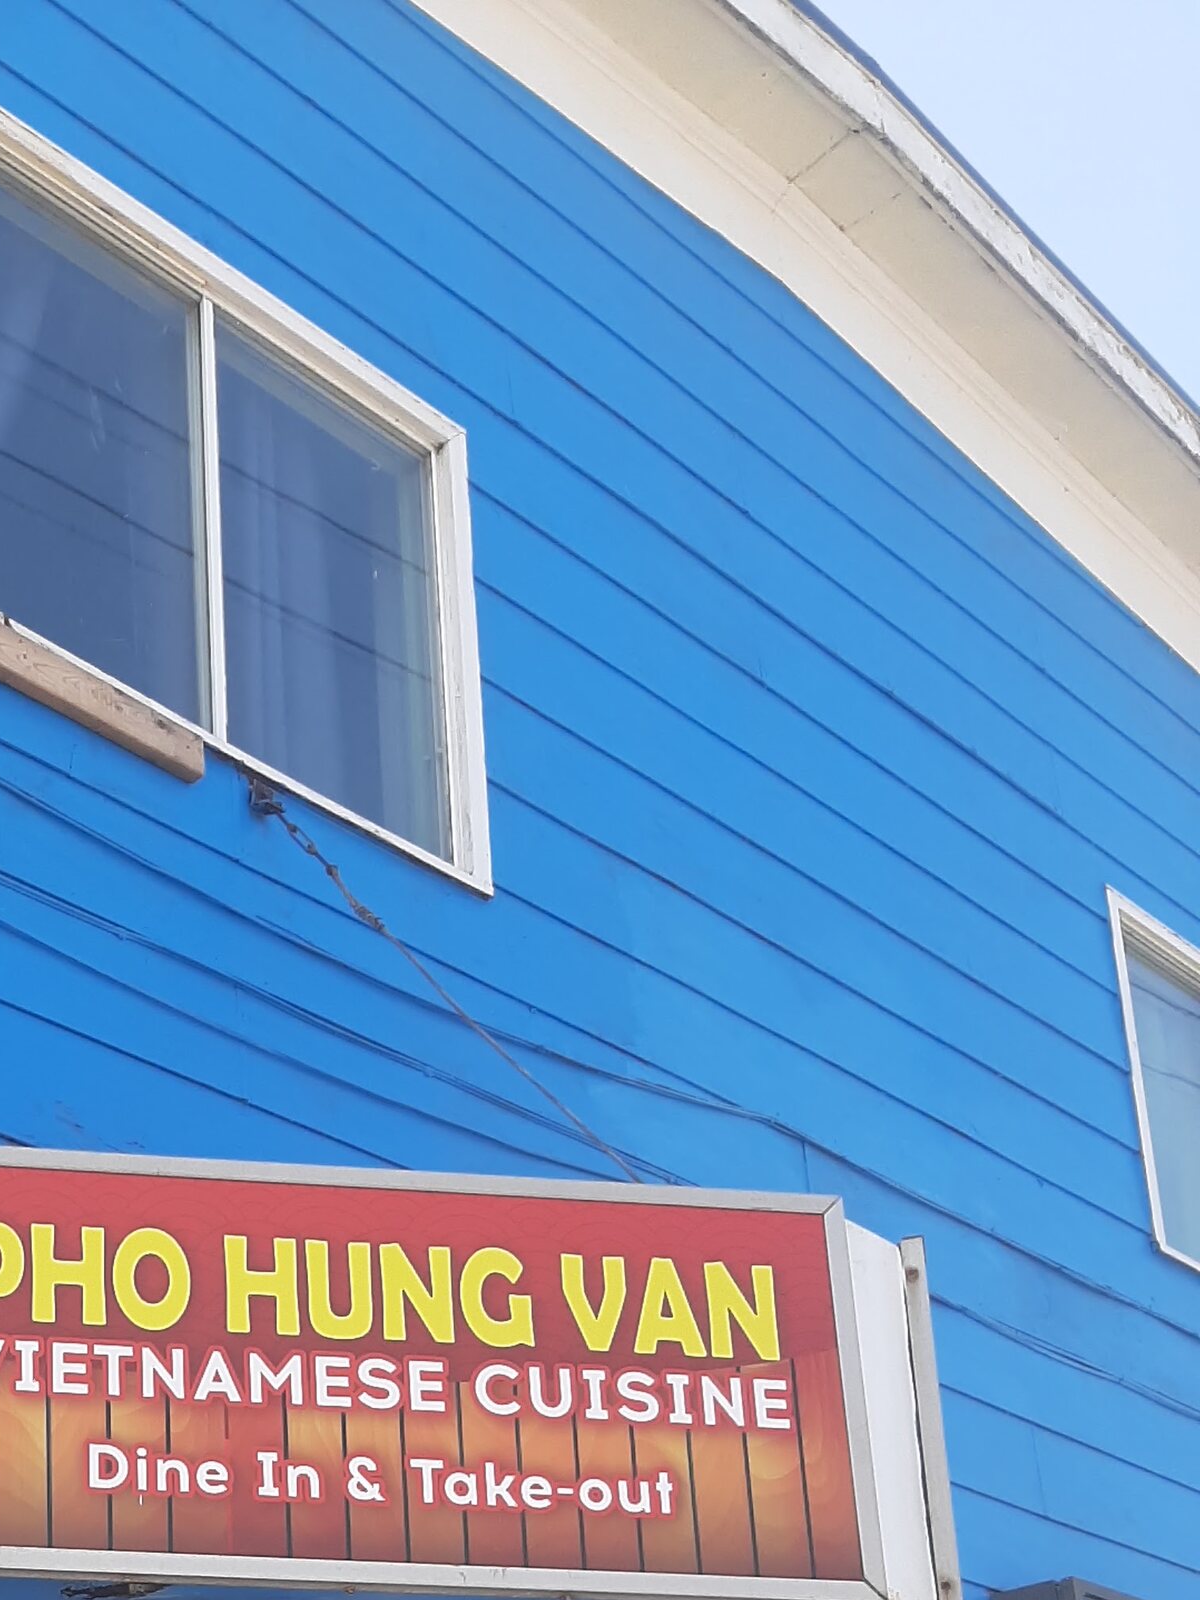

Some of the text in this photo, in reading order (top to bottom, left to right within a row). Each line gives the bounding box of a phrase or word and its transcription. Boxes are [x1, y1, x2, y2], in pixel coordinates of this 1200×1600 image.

[223, 1235, 535, 1347] HUNG
[559, 1254, 780, 1361] VAN
[472, 1362, 793, 1432] CUISINE
[85, 1442, 676, 1516] Dine In & Take-out
